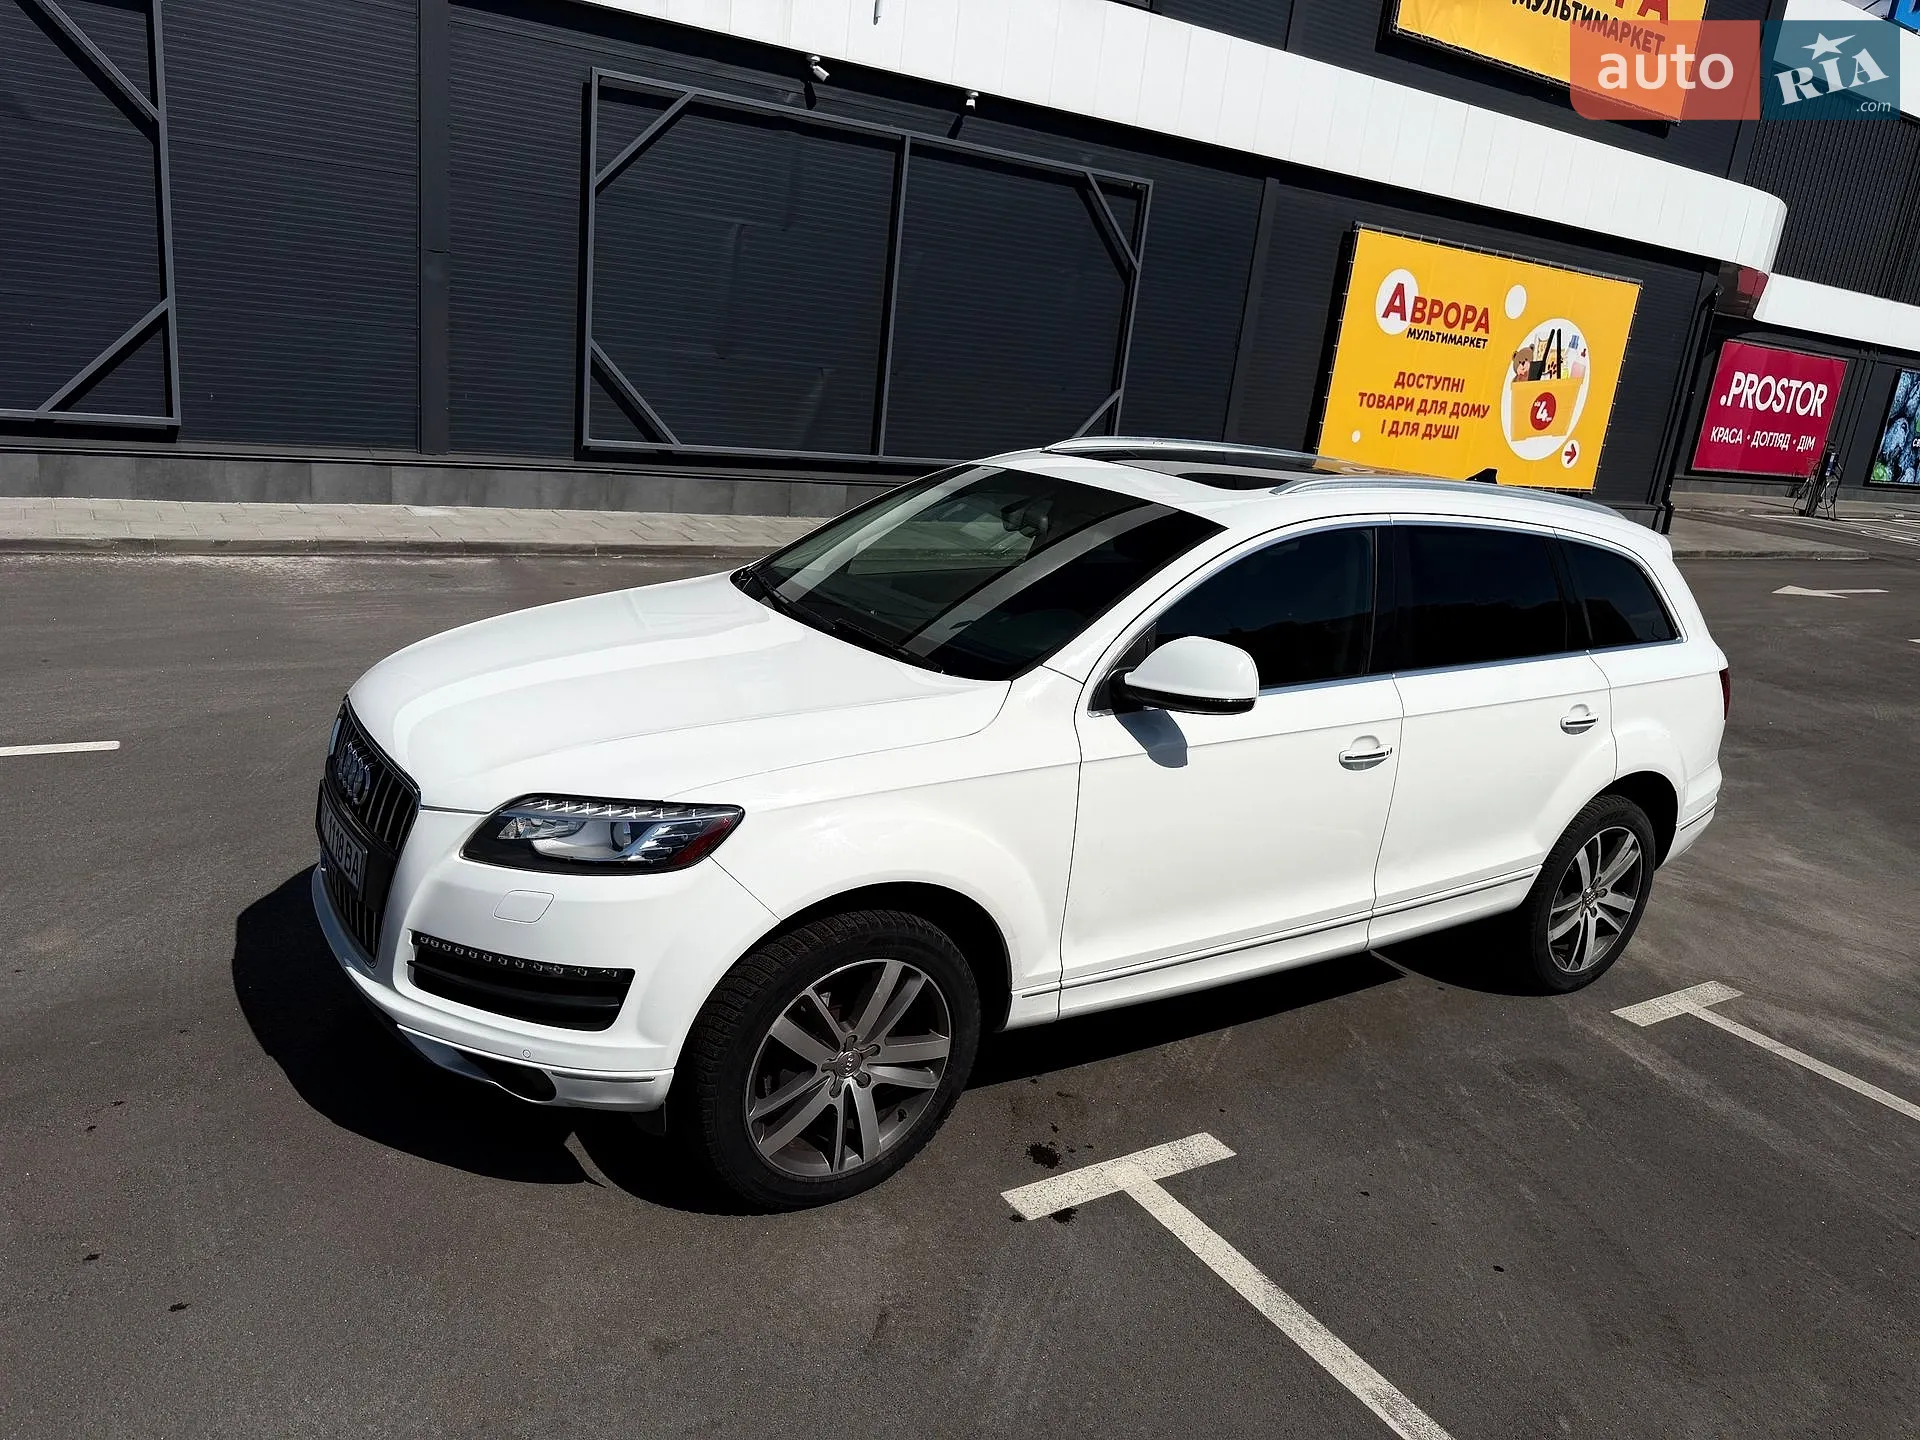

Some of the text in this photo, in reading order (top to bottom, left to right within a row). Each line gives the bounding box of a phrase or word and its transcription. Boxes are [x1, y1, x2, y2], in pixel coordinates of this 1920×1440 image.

[1406, 327, 1488, 350] МУЛЬТИМАРКЕТ
[1394, 371, 1465, 393] ДОСТУПНІ
[1358, 392, 1490, 419] ТОВАРИ ДЛЯ ДОМУ
[1381, 419, 1460, 440] І ДЛЯ ДУШІ
[1710, 426, 1816, 452] КРАСА ДОГЛЯД ДІМ
